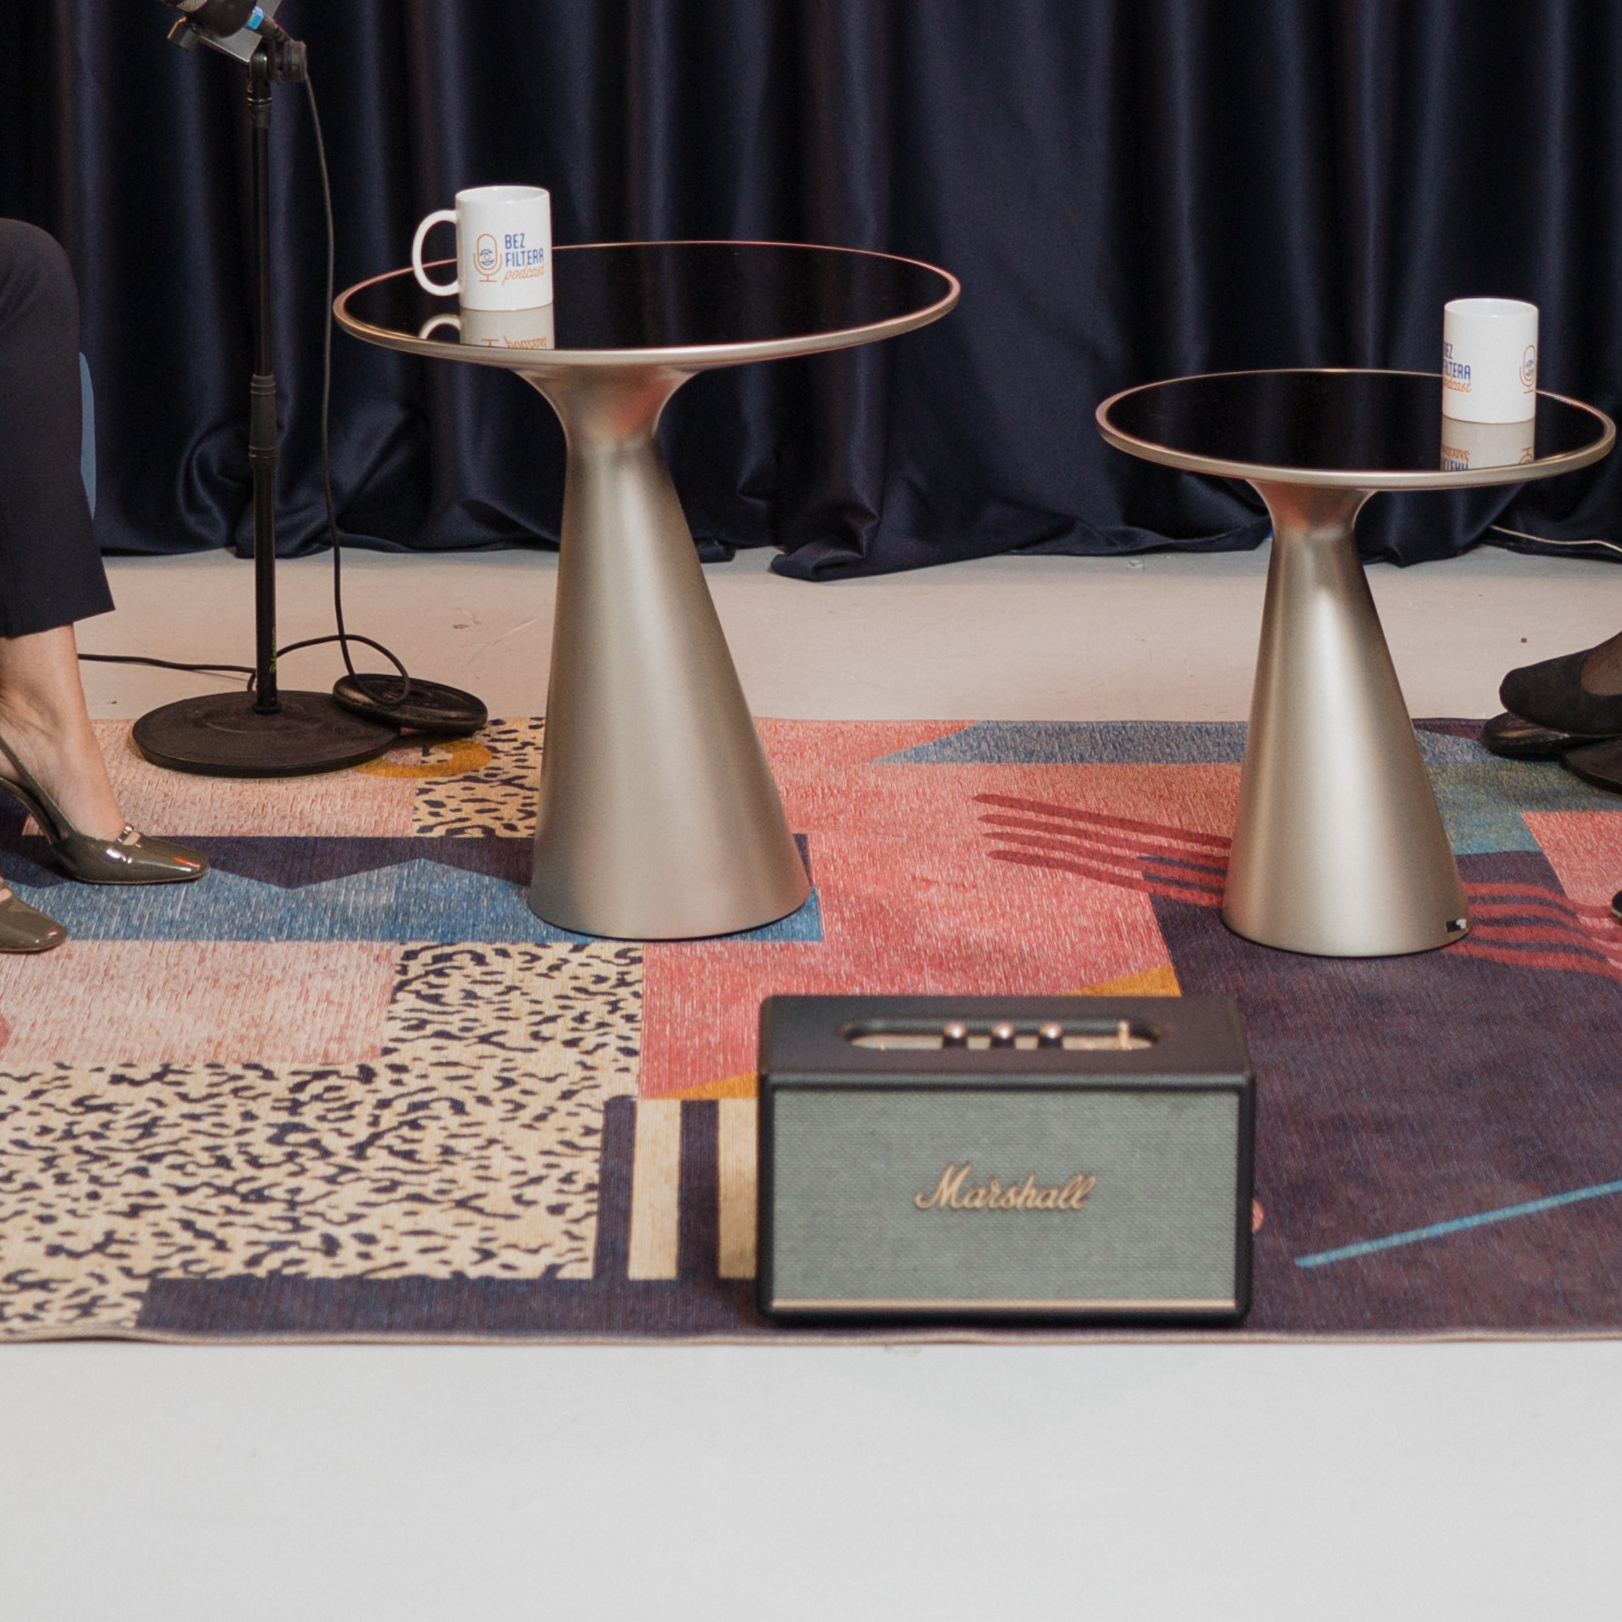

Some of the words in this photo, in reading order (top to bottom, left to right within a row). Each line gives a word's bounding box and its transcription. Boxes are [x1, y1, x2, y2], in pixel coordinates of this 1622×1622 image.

[504, 233, 525, 249] BEZ
[505, 247, 544, 267] FILTERA
[1443, 341, 1453, 359] EZ
[913, 1162, 1097, 1211] Marshall
